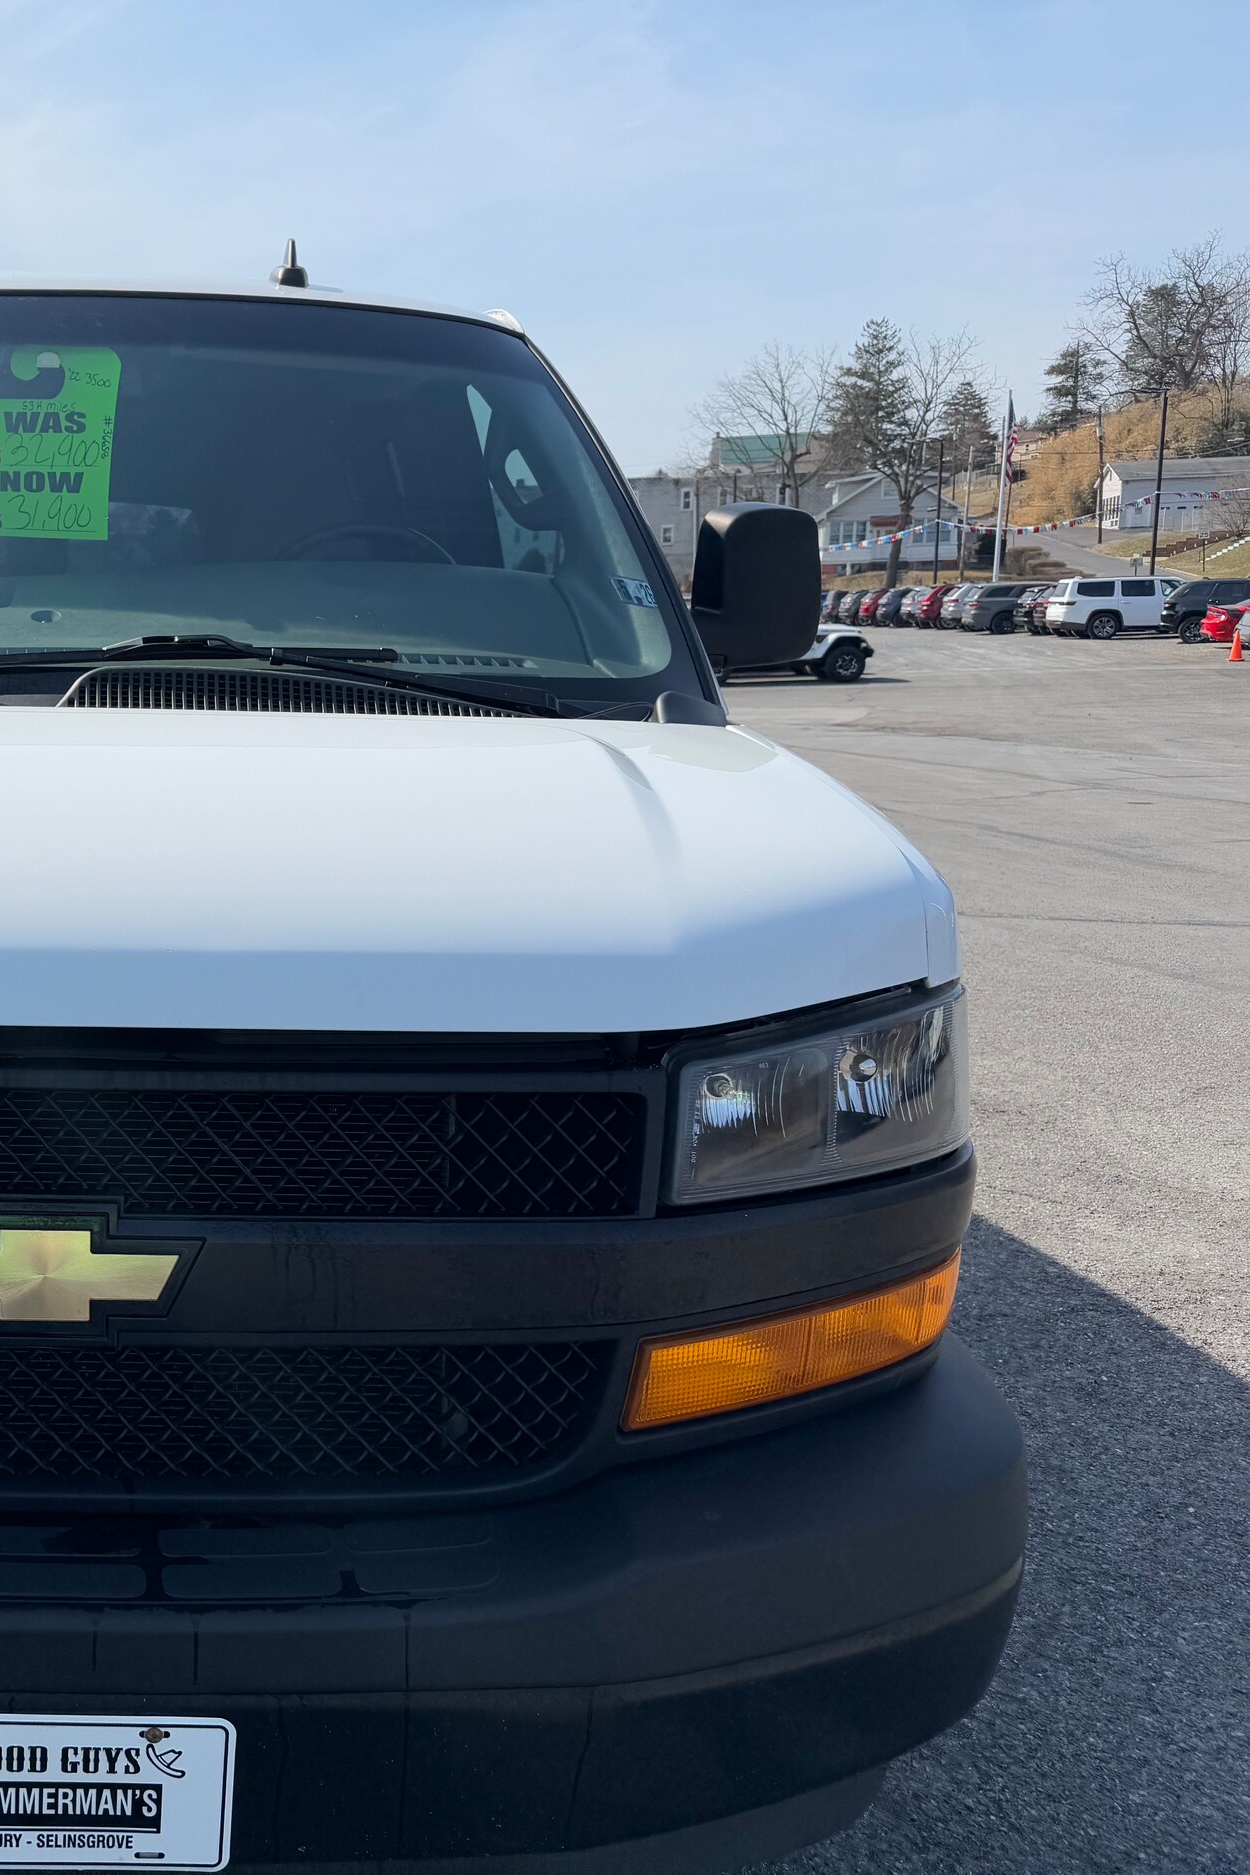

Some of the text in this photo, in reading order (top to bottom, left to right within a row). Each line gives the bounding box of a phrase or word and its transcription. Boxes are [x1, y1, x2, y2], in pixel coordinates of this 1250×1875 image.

[85, 371, 112, 388] 3500
[3, 411, 87, 434] WAS
[0, 471, 84, 493] NOW
[7, 494, 92, 531] 31,900
[60, 1746, 141, 1774] GUYS
[36, 1834, 134, 1849] SELINSGROVE
